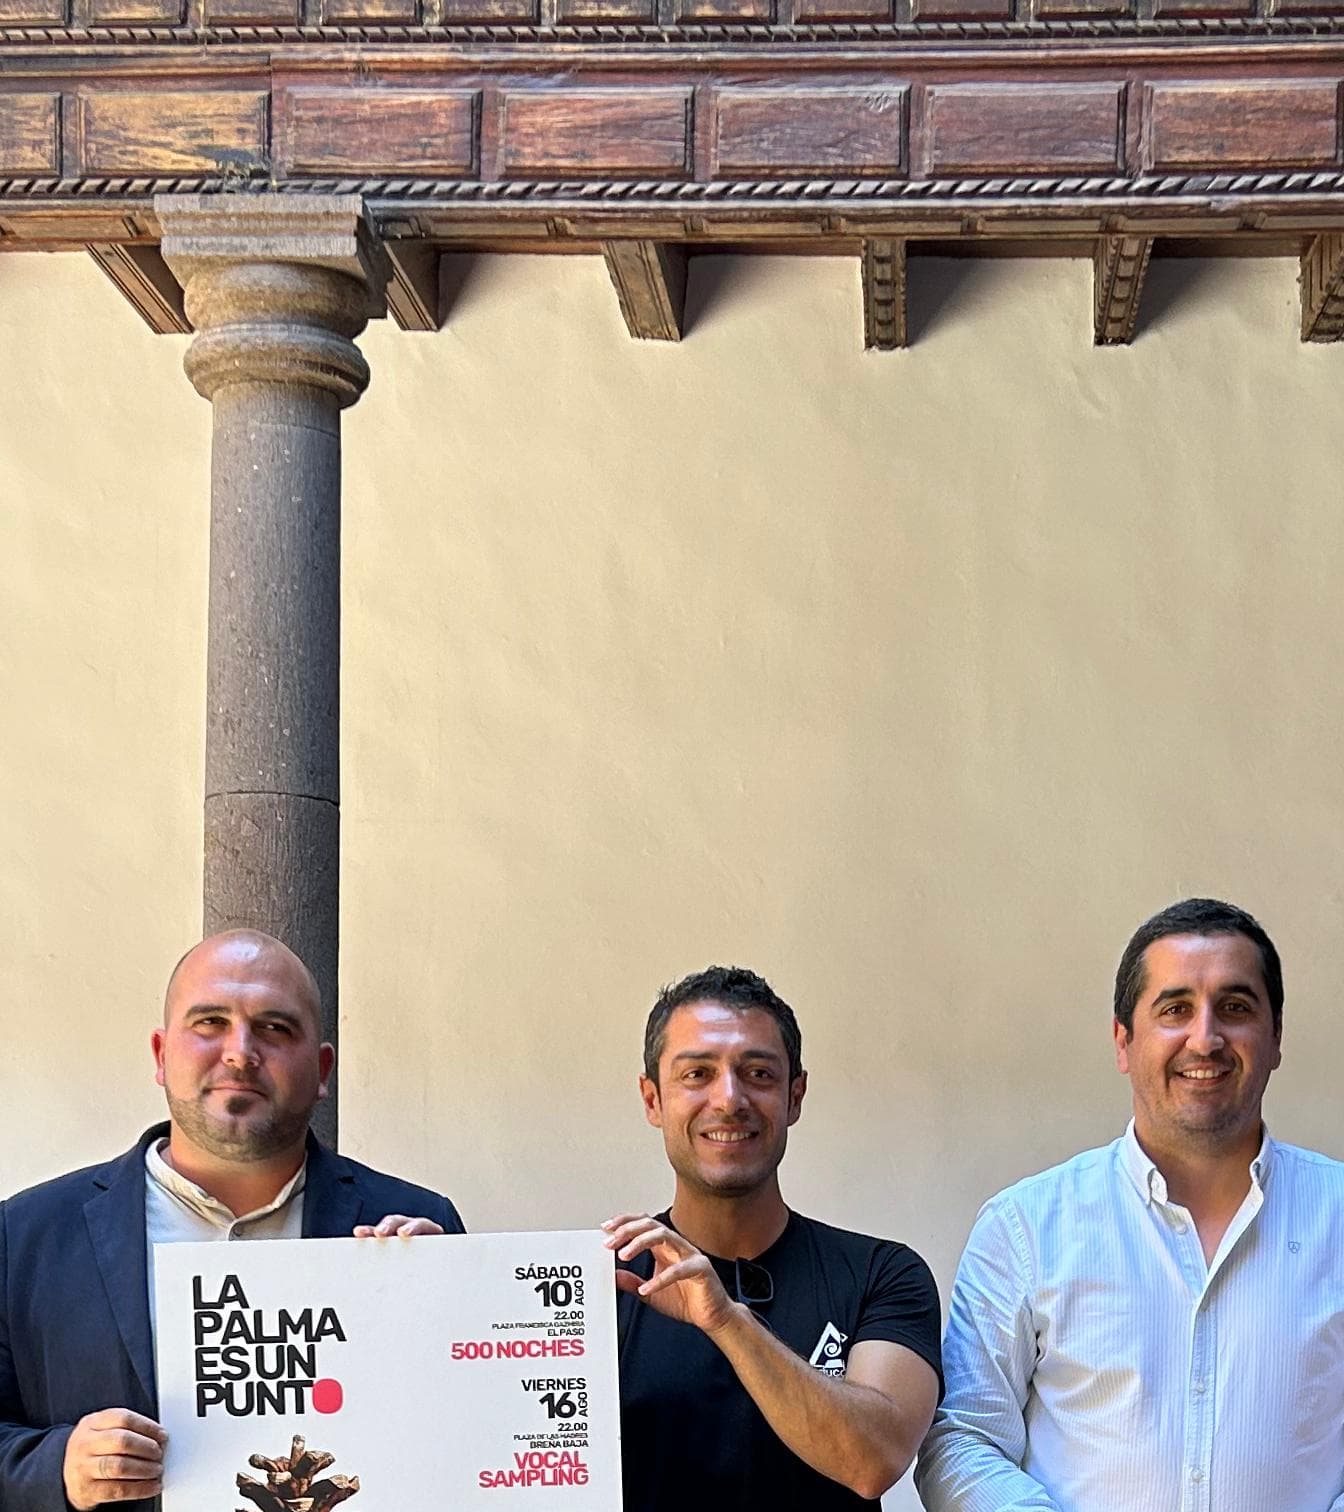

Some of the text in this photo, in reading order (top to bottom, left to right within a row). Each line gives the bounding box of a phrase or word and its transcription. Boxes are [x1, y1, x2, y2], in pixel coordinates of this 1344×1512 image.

[515, 1262, 582, 1280] SÁBADO
[192, 1274, 250, 1310] LA
[534, 1280, 572, 1307] 10
[574, 1280, 584, 1305] AGO
[194, 1307, 347, 1345] PALMA
[554, 1311, 584, 1320] 22.00
[560, 1328, 585, 1336] PASO
[451, 1339, 585, 1360] 500 NOCHES
[195, 1344, 316, 1381] ES UN
[521, 1378, 586, 1391] VIERNES
[539, 1392, 576, 1419] 16
[578, 1392, 588, 1417] AGO
[557, 1422, 588, 1431] 22.00
[513, 1451, 587, 1469] VOCAL
[479, 1468, 588, 1488] SAMPLING
